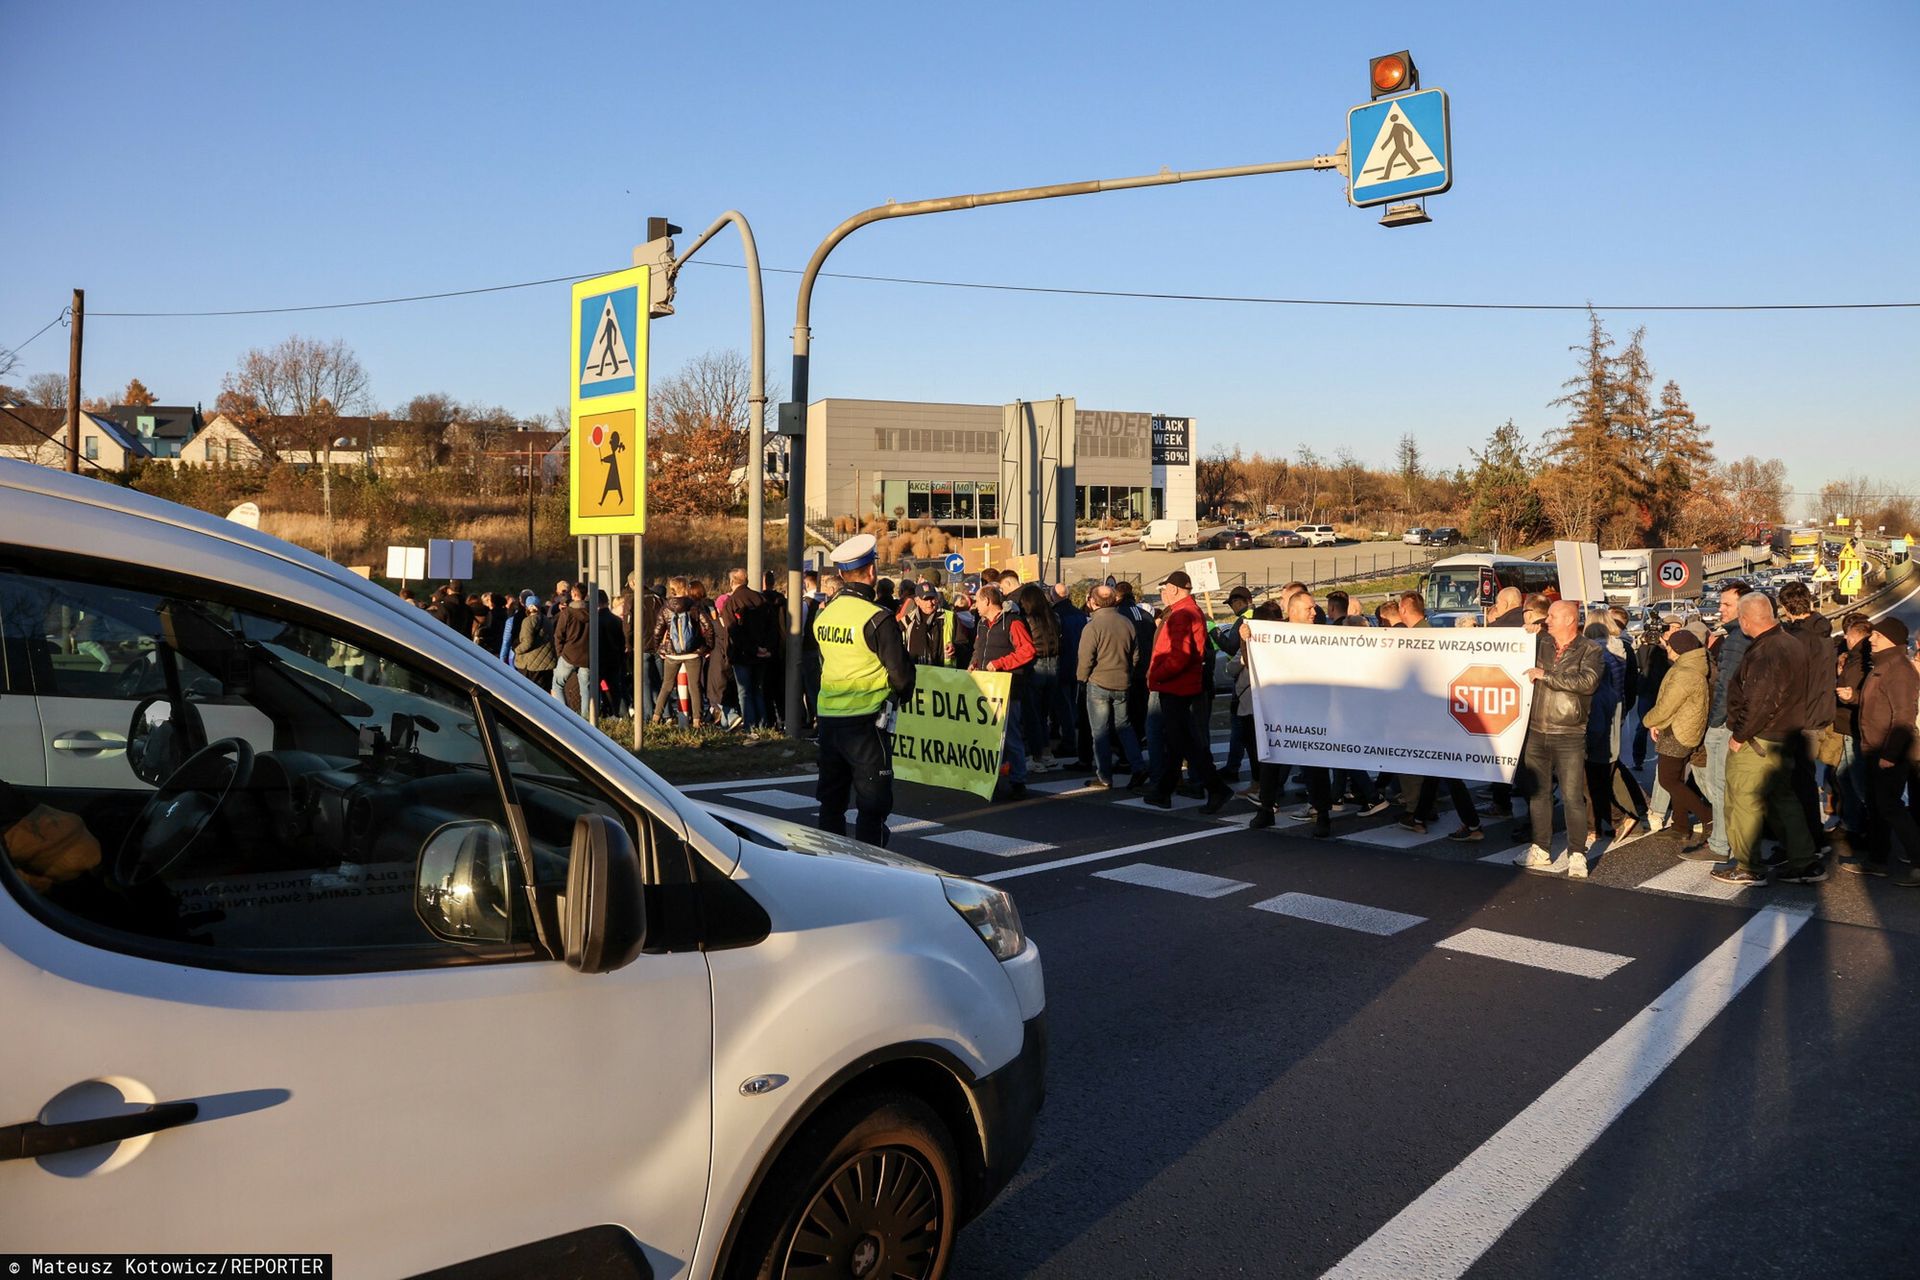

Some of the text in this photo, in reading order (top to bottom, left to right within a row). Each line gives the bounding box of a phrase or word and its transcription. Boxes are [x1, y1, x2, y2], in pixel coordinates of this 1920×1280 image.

[1152, 420, 1184, 431] BLACK
[1154, 434, 1183, 445] WEEK
[1160, 451, 1188, 461] -50%!
[1663, 567, 1683, 581] 50
[817, 625, 853, 645] POLICJA
[1274, 634, 1297, 644] DLA
[1300, 635, 1378, 648] WARIANTÓW
[1380, 638, 1395, 648] S7
[1398, 639, 1435, 650] PRZEZ
[1438, 640, 1526, 654] WRZĄSOWICE
[932, 690, 970, 723] DLA
[976, 696, 1003, 726] S7
[1454, 685, 1516, 715] STOP
[1285, 725, 1327, 736] HAŁASU!
[921, 738, 1000, 775] KRAKÓW
[1283, 740, 1361, 753] ZWIĘKSZONEGO
[1363, 745, 1462, 762] ZANIECZYSZCZENIA
